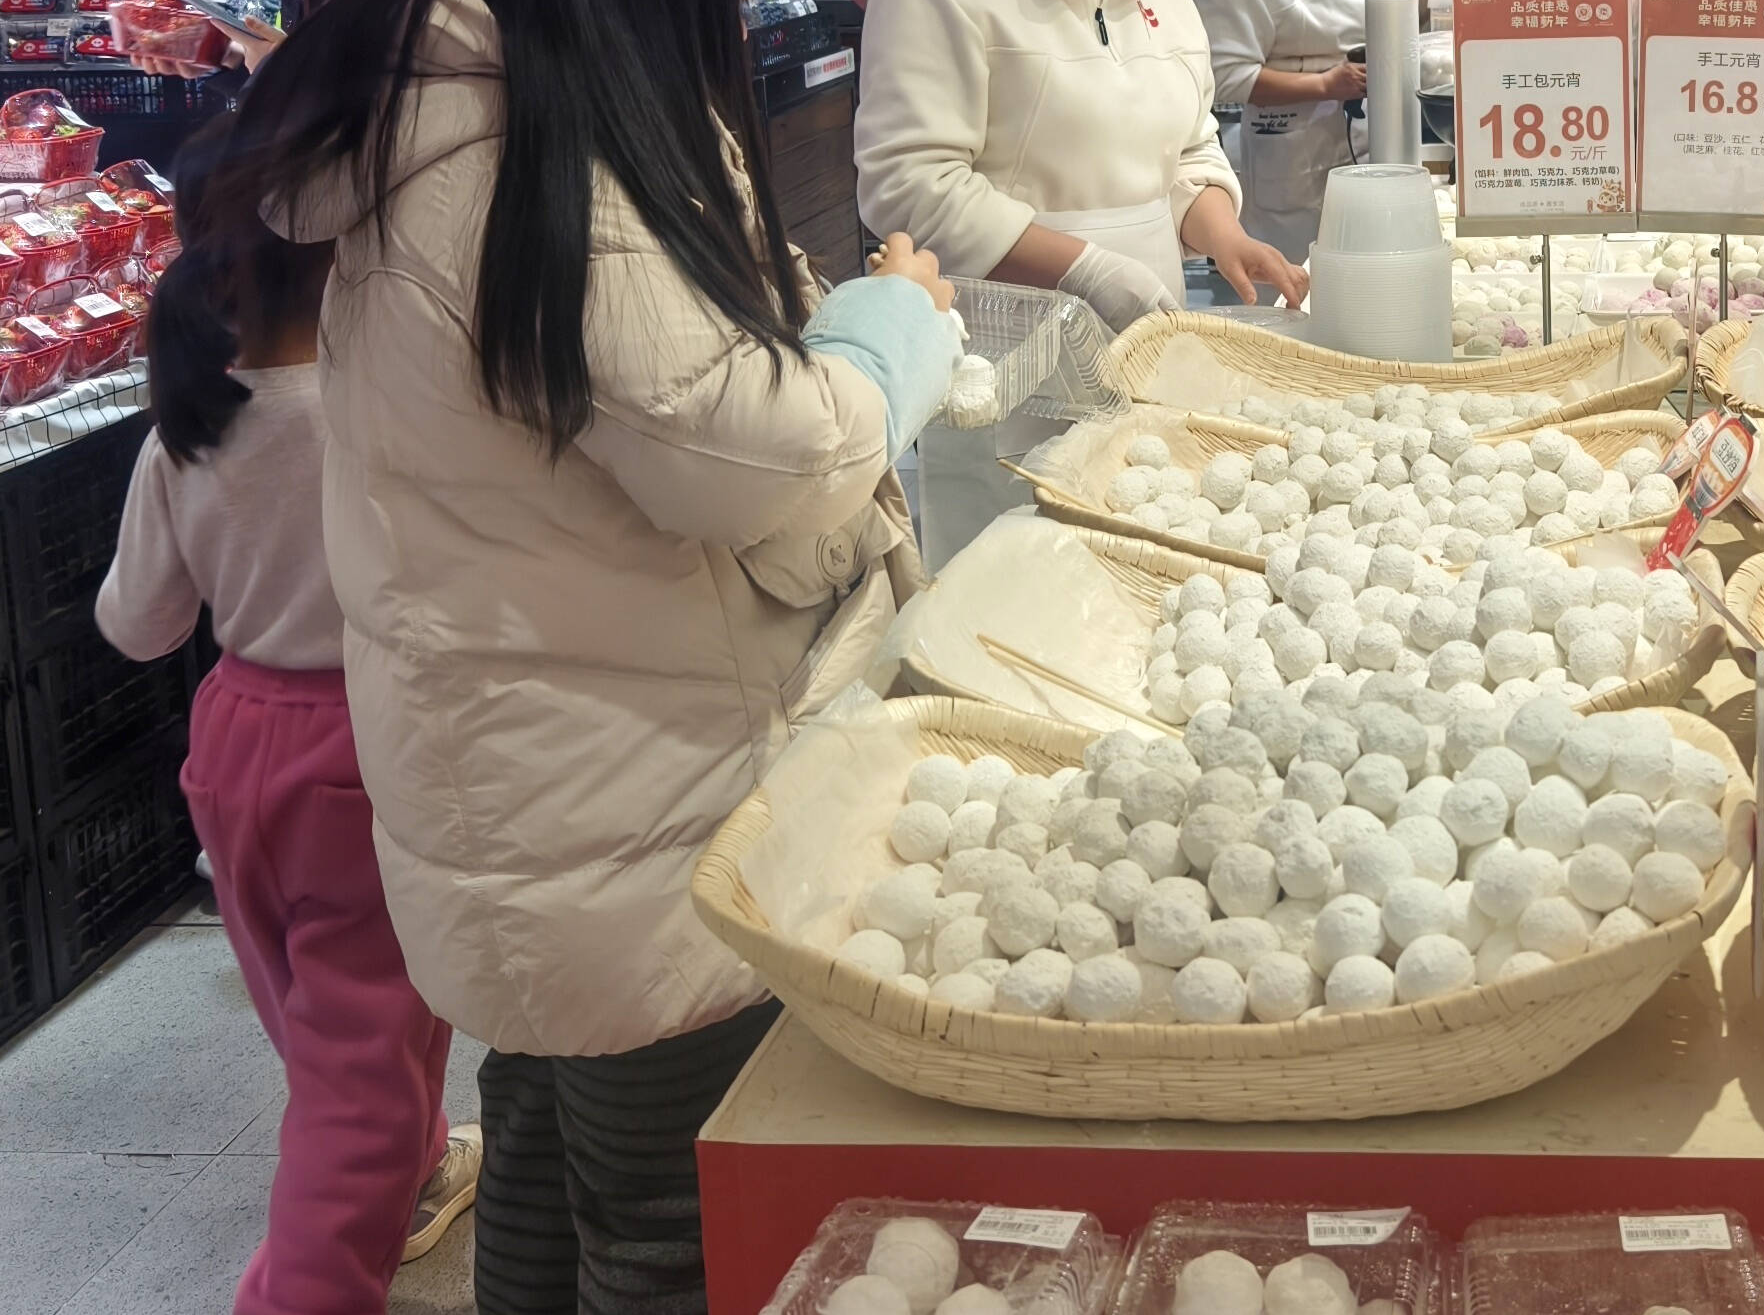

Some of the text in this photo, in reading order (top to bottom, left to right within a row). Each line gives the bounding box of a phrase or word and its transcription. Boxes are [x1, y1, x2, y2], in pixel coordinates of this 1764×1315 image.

[1510, 0, 1570, 14] 品质佳惠
[1511, 15, 1569, 29] 幸福新年
[1698, 14, 1757, 28] 幸福新年
[1697, 52, 1762, 69] 手工元宵
[1502, 72, 1582, 90] 手工包元宵
[1681, 79, 1758, 115] 16.8
[1479, 103, 1610, 160] 18.80
[1570, 145, 1609, 162] 元/斤
